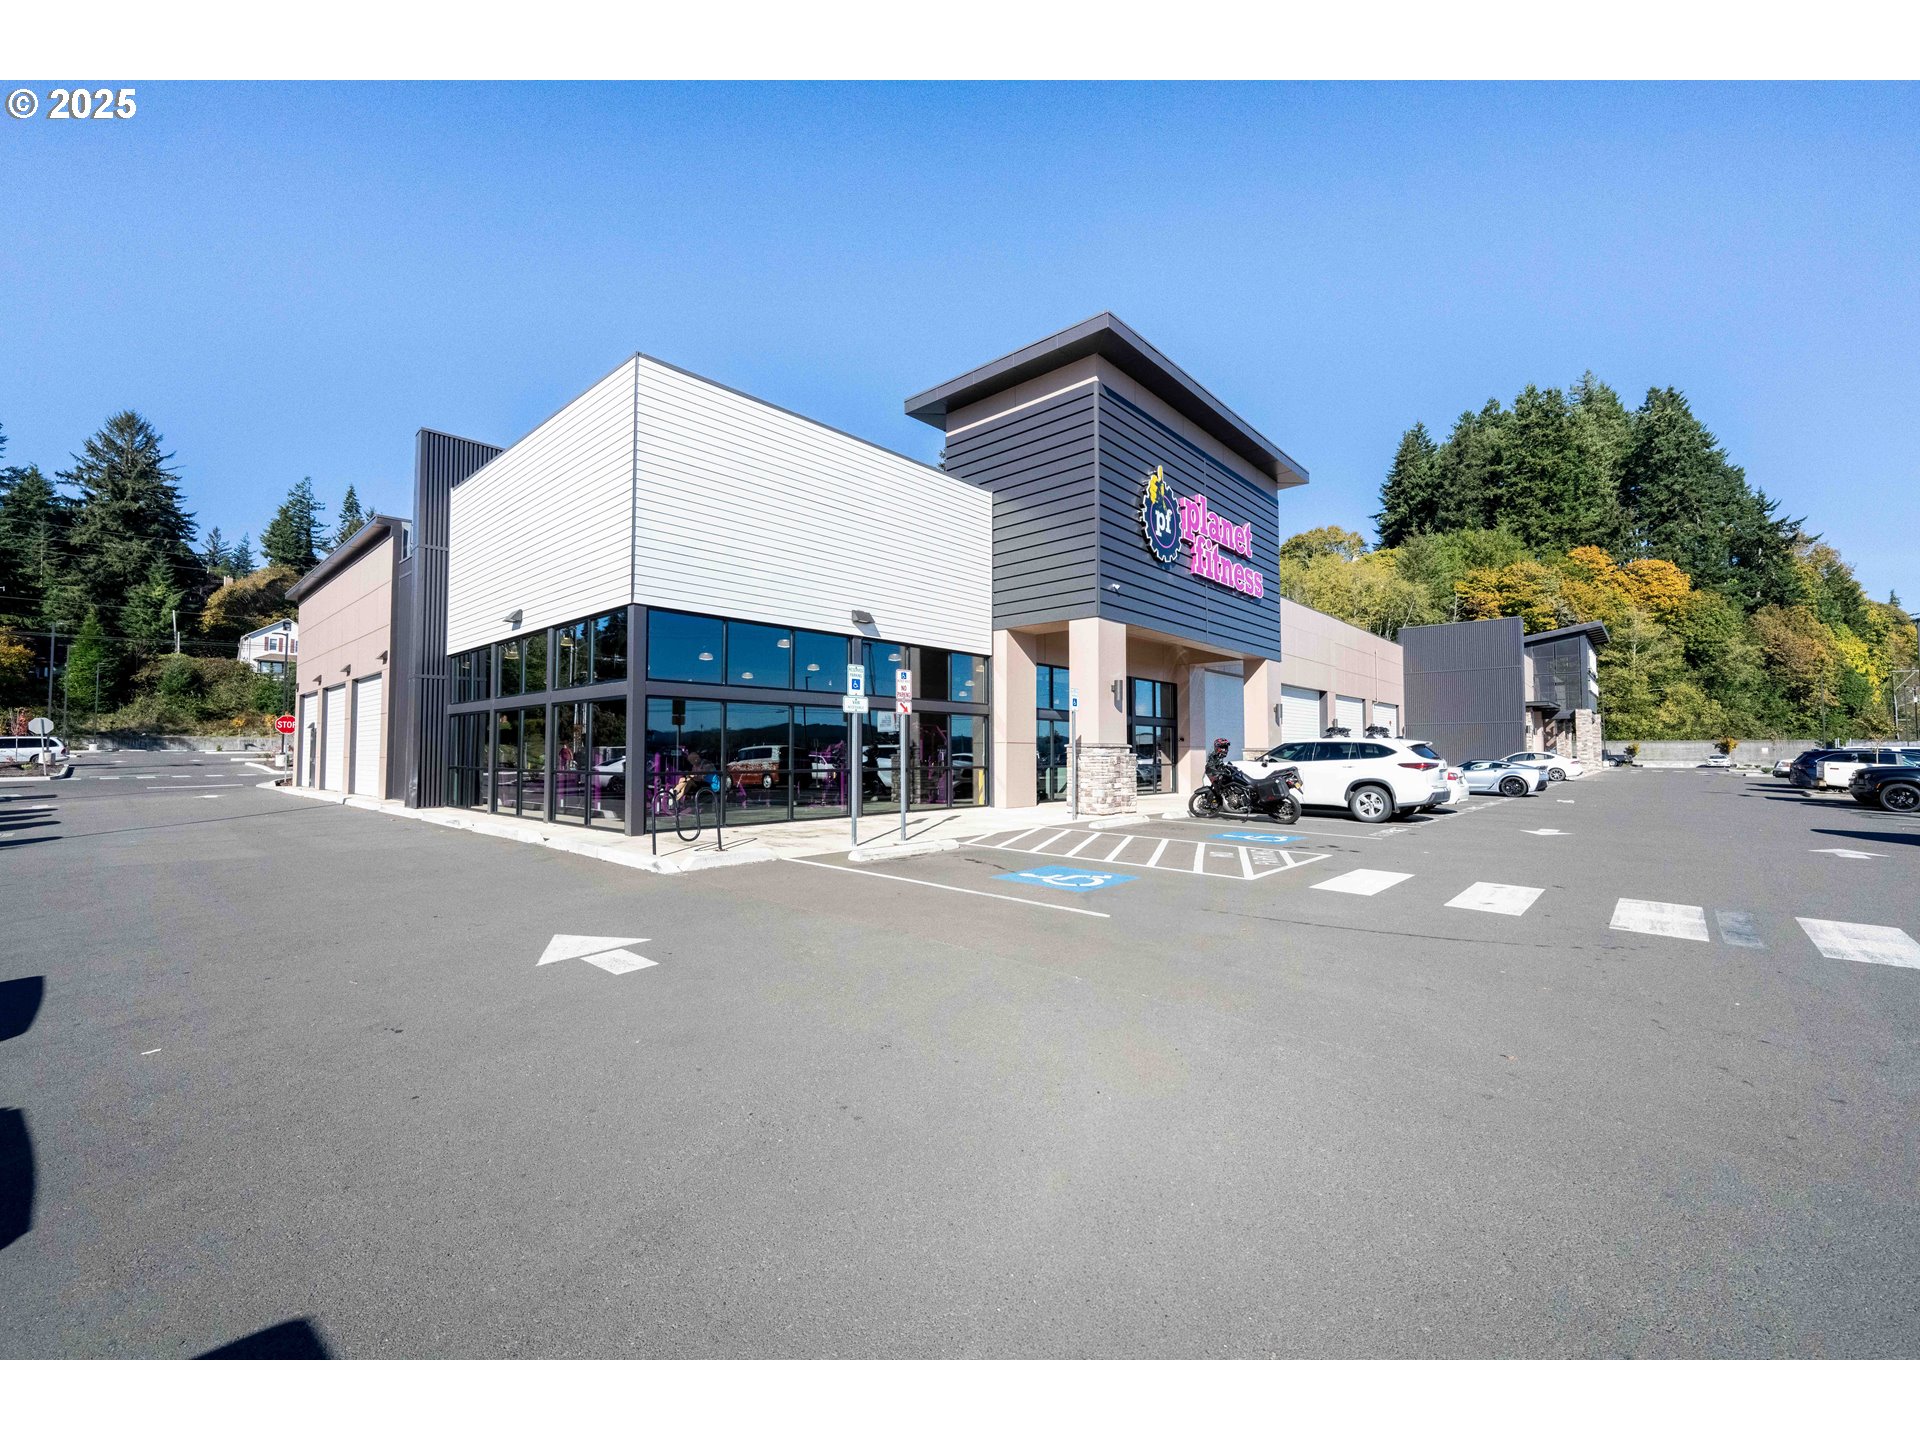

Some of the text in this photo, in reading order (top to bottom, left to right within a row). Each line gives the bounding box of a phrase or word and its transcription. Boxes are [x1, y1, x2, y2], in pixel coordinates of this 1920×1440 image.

[1155, 509, 1172, 536] pf
[1180, 494, 1253, 558] planet
[1191, 534, 1264, 598] fitness
